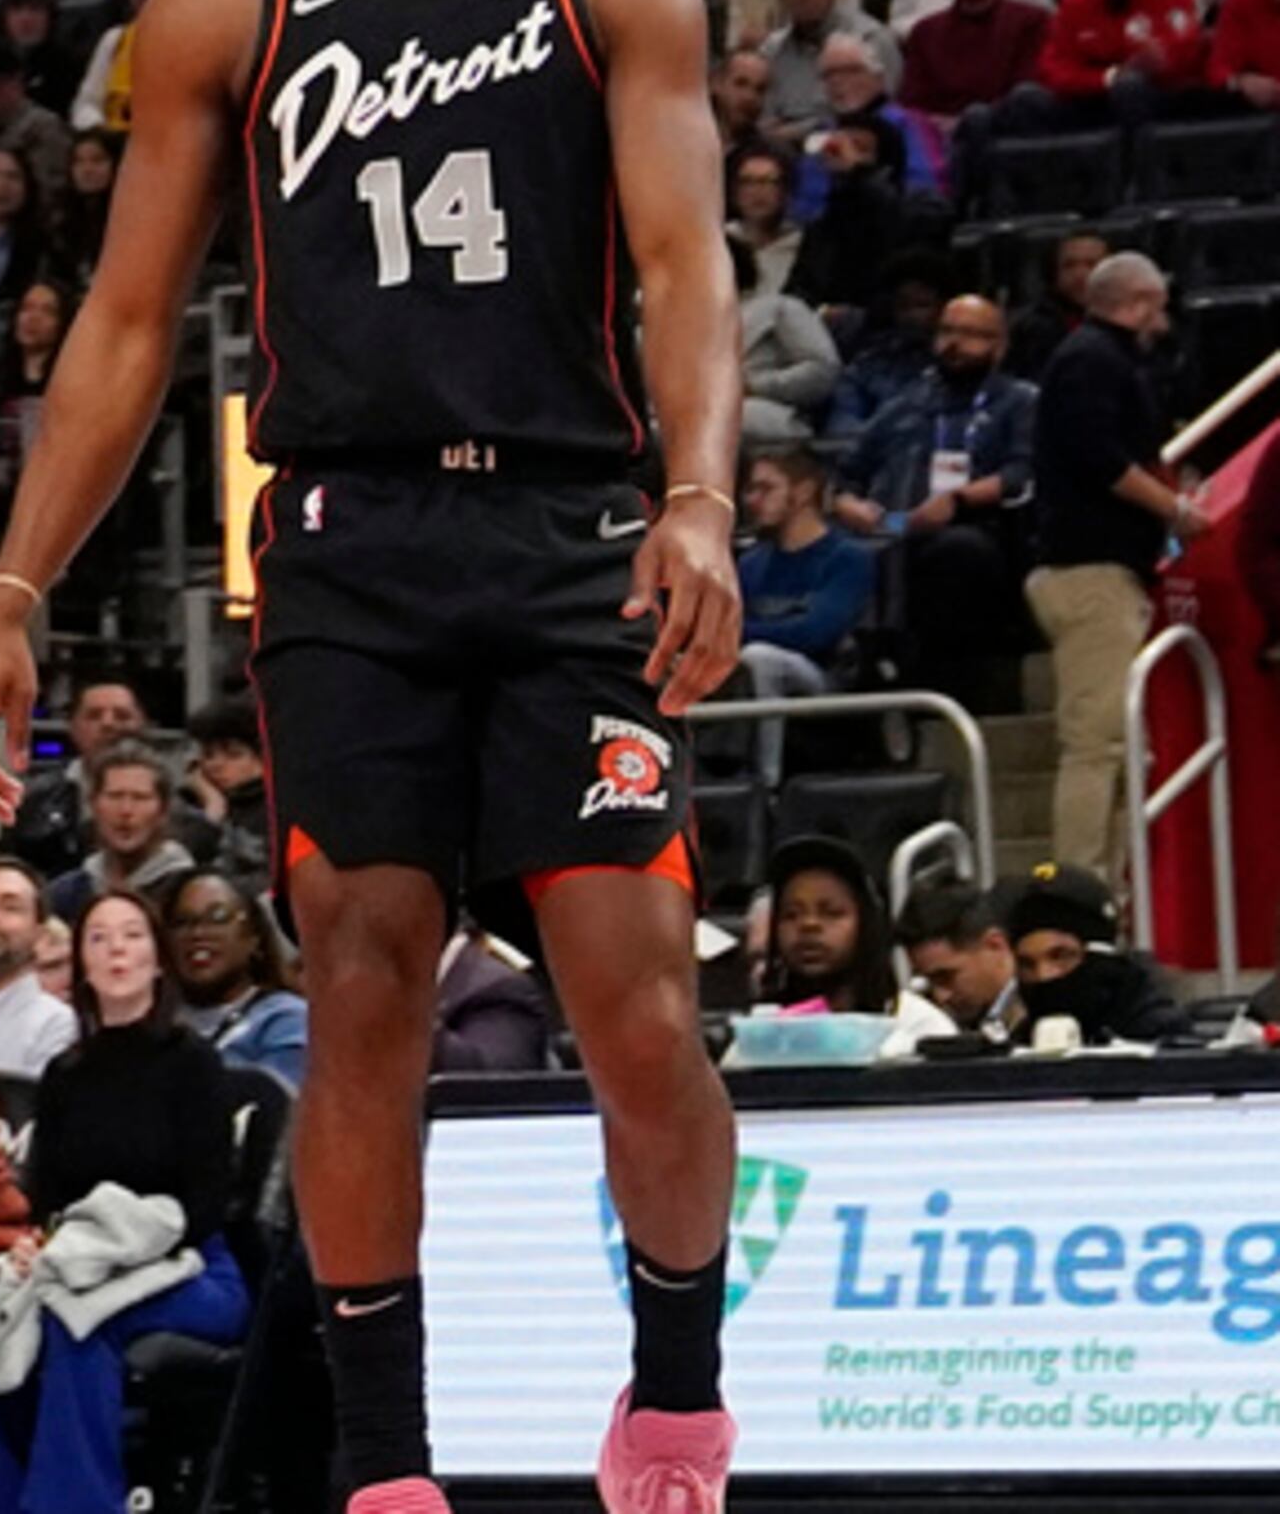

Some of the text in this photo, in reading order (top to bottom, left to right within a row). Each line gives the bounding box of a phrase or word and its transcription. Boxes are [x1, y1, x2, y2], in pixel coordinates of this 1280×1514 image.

[269, 0, 556, 202] Detroit
[355, 147, 509, 288] 14
[833, 1189, 1280, 1344] Lineag
[818, 1393, 966, 1431] World's
[974, 1393, 1074, 1429] Food
[1086, 1390, 1222, 1438] Supply
[824, 1337, 1136, 1386] Reimagining the
